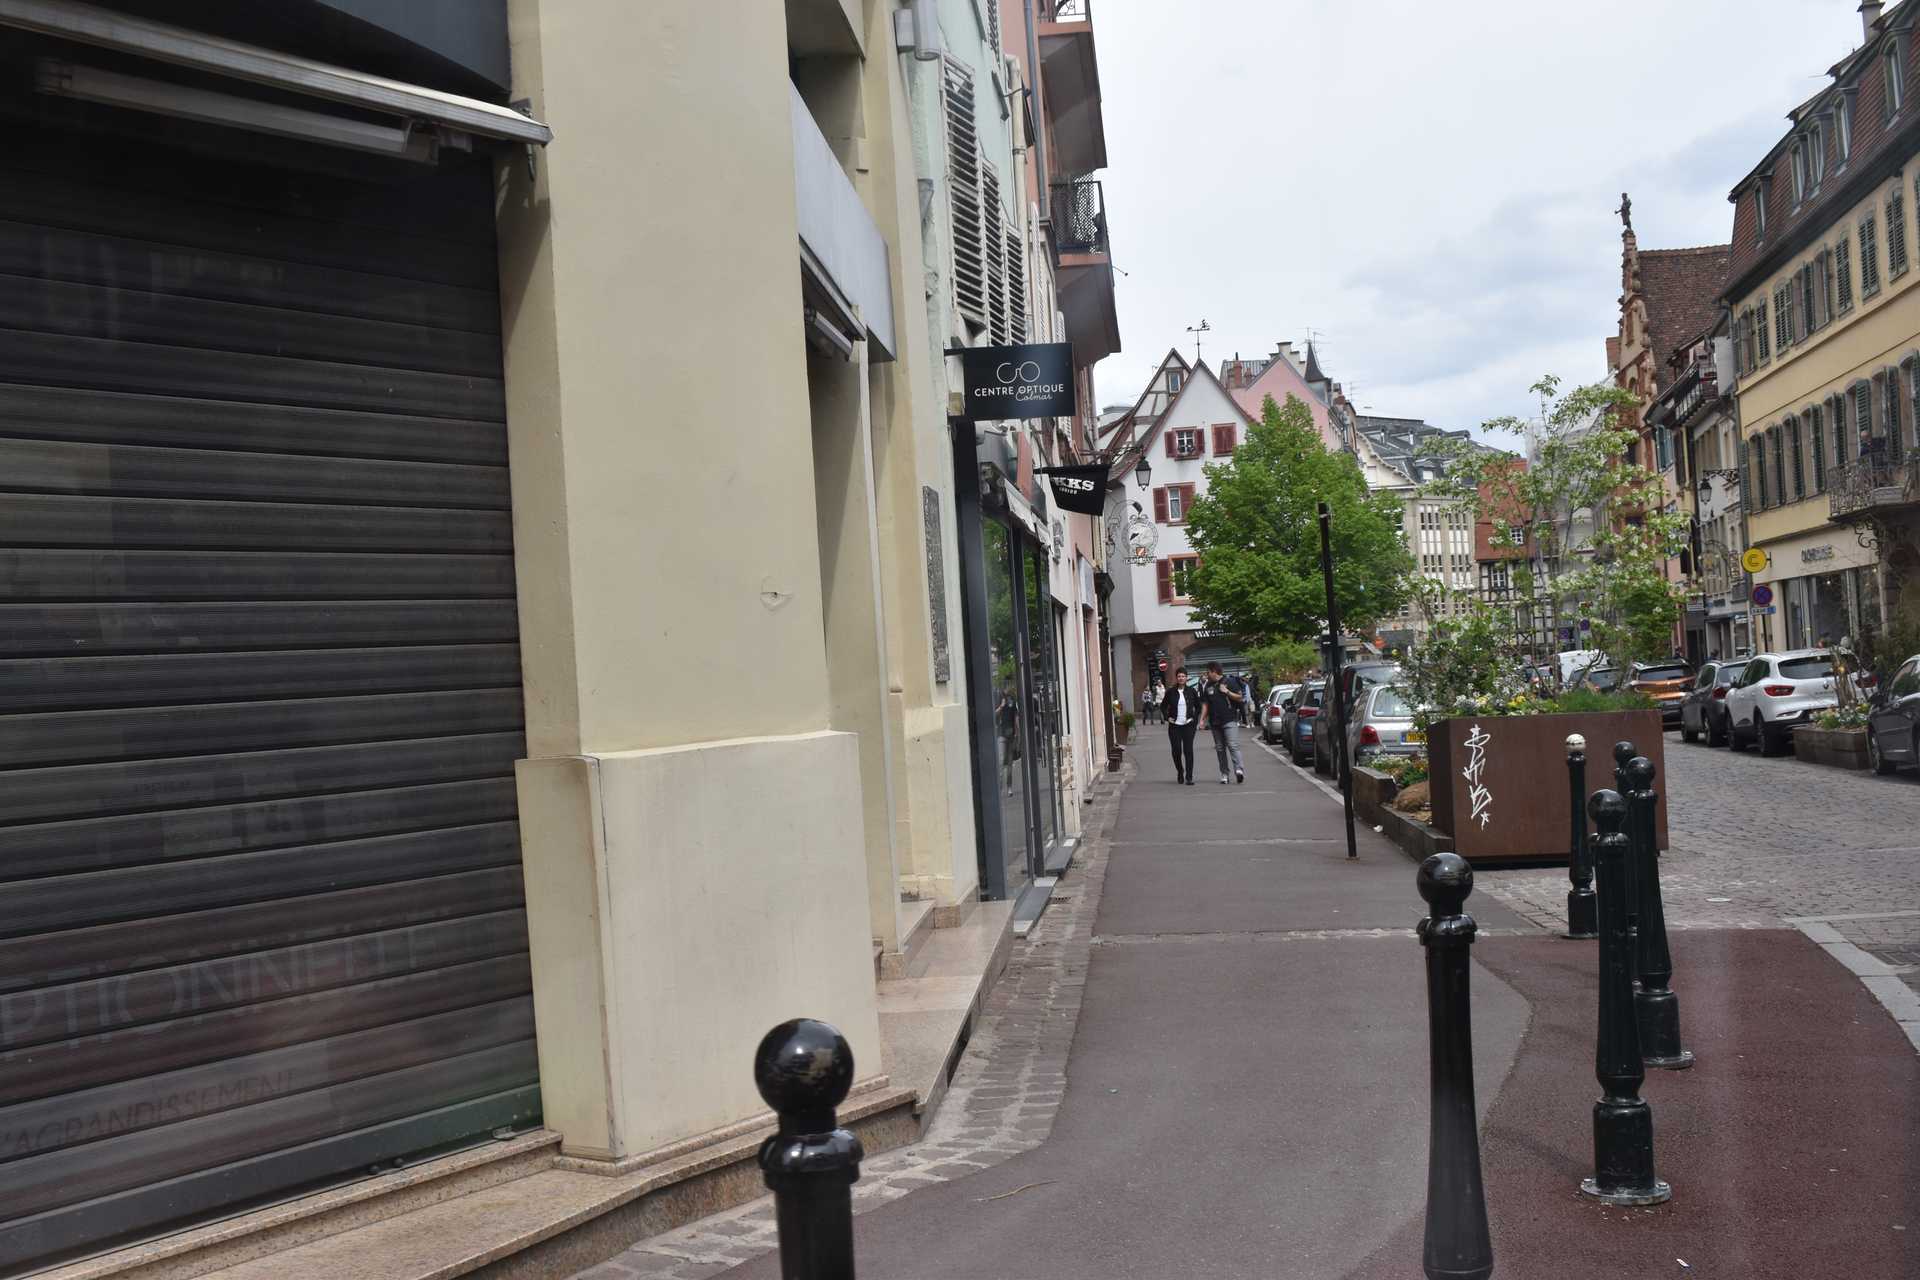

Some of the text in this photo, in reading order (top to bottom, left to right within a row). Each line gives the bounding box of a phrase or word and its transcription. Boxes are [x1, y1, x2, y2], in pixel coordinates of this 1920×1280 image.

[974, 384, 1064, 397] CENTRE OPTIQUE
[1015, 390, 1053, 402] Colmar
